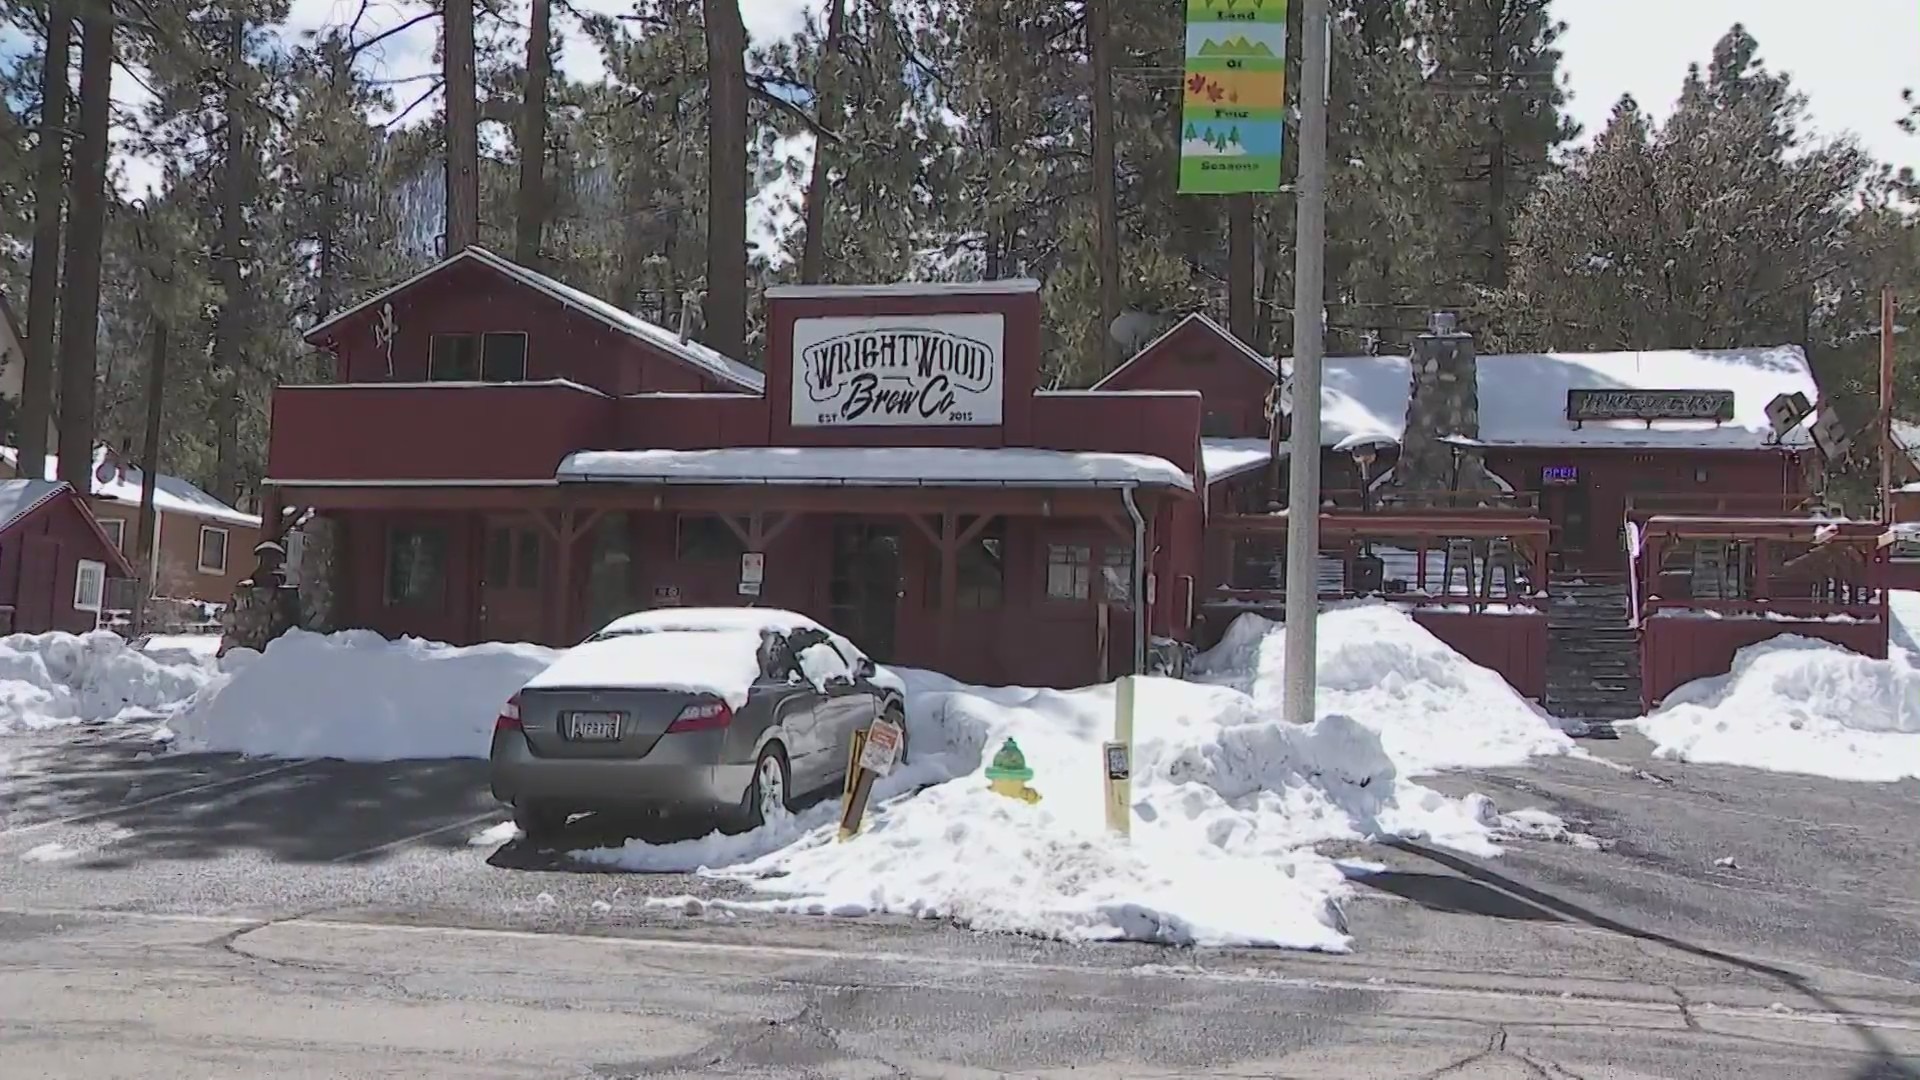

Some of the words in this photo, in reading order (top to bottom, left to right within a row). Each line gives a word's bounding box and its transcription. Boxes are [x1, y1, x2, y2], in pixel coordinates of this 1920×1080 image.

[1217, 11, 1255, 20] Land
[1215, 108, 1249, 118] Four
[1201, 161, 1259, 170] Seasons
[813, 334, 985, 390] WRIGHTWOOD
[841, 373, 919, 421] Brew
[818, 413, 837, 423] EST
